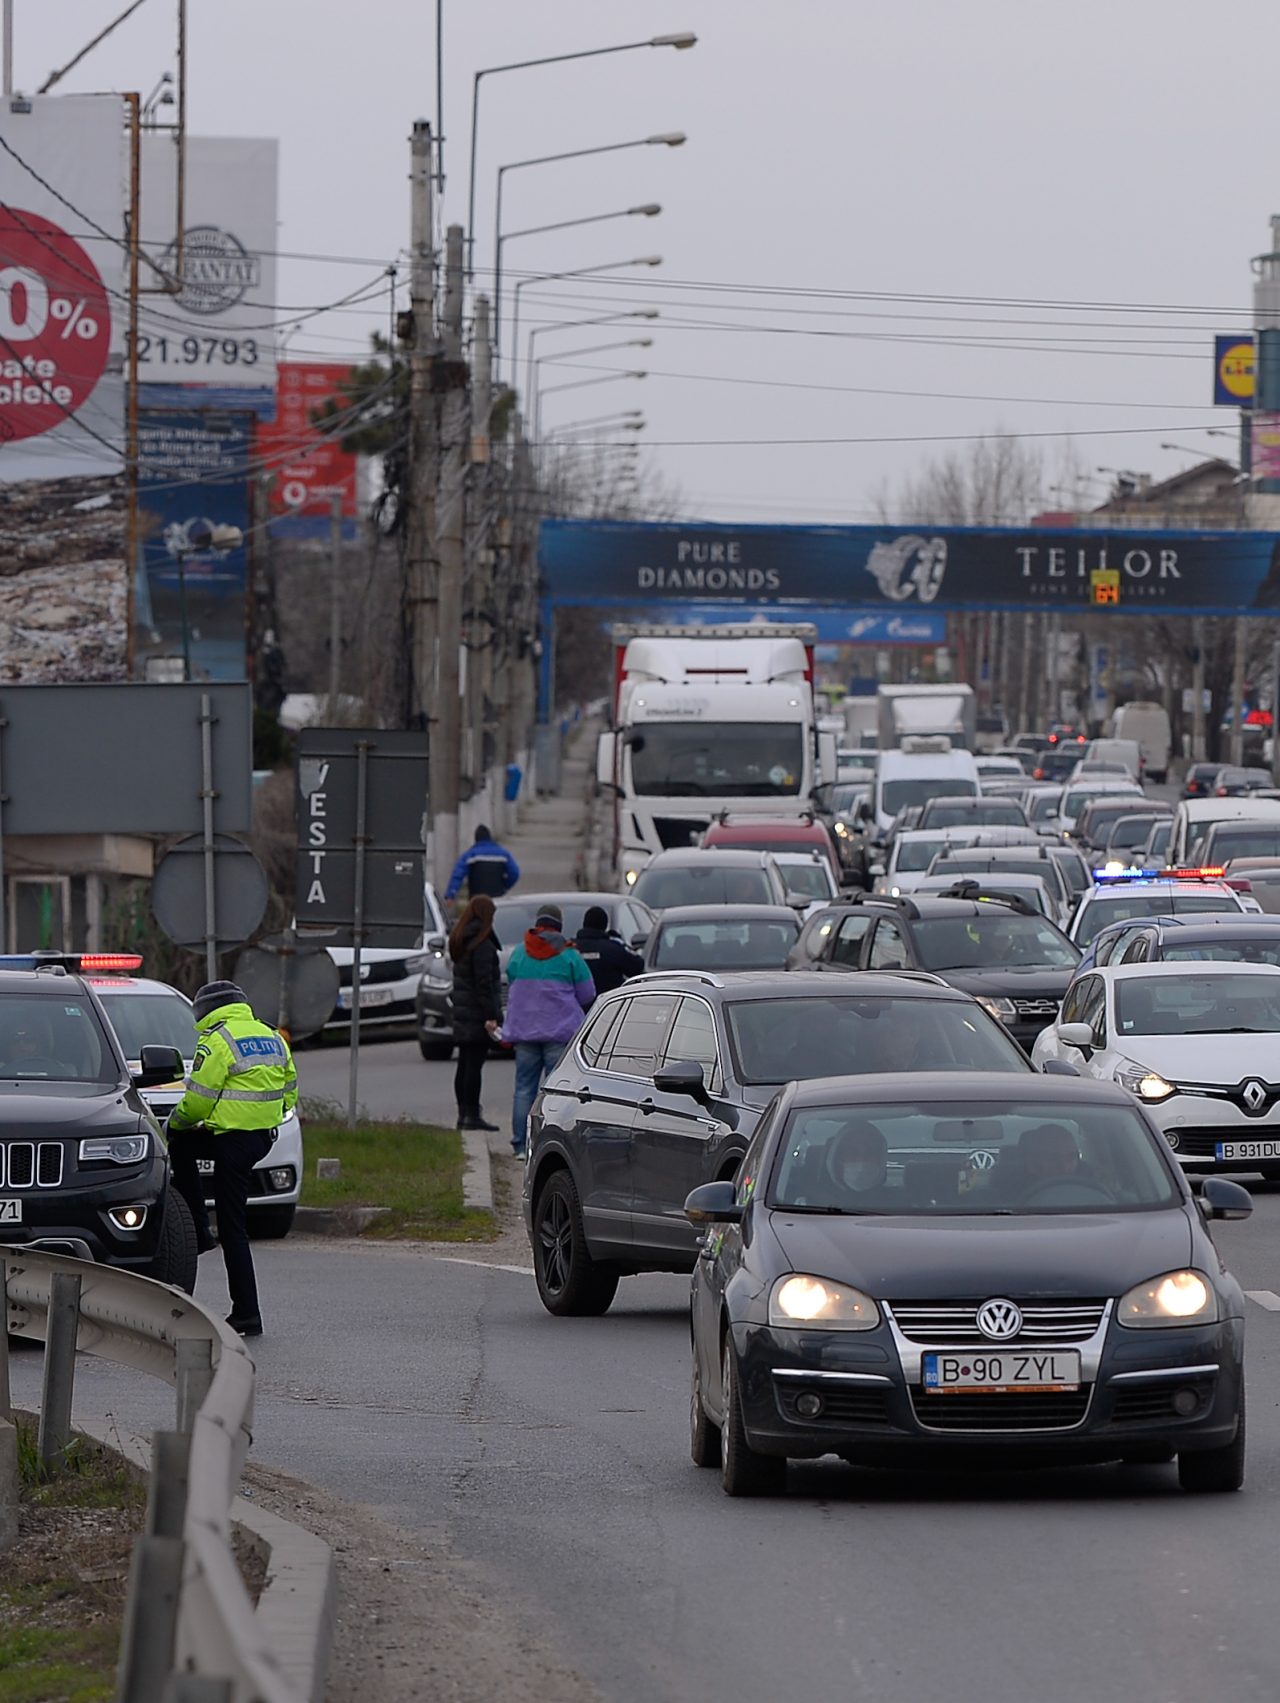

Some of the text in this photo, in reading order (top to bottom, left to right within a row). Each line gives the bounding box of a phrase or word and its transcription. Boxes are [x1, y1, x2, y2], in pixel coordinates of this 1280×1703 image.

[0, 354, 56, 378] ate
[678, 541, 741, 563] PURE
[638, 568, 780, 590] DIAMONDS
[1224, 1144, 1235, 1158] B
[943, 1356, 1065, 1382] B 90 ZYL
